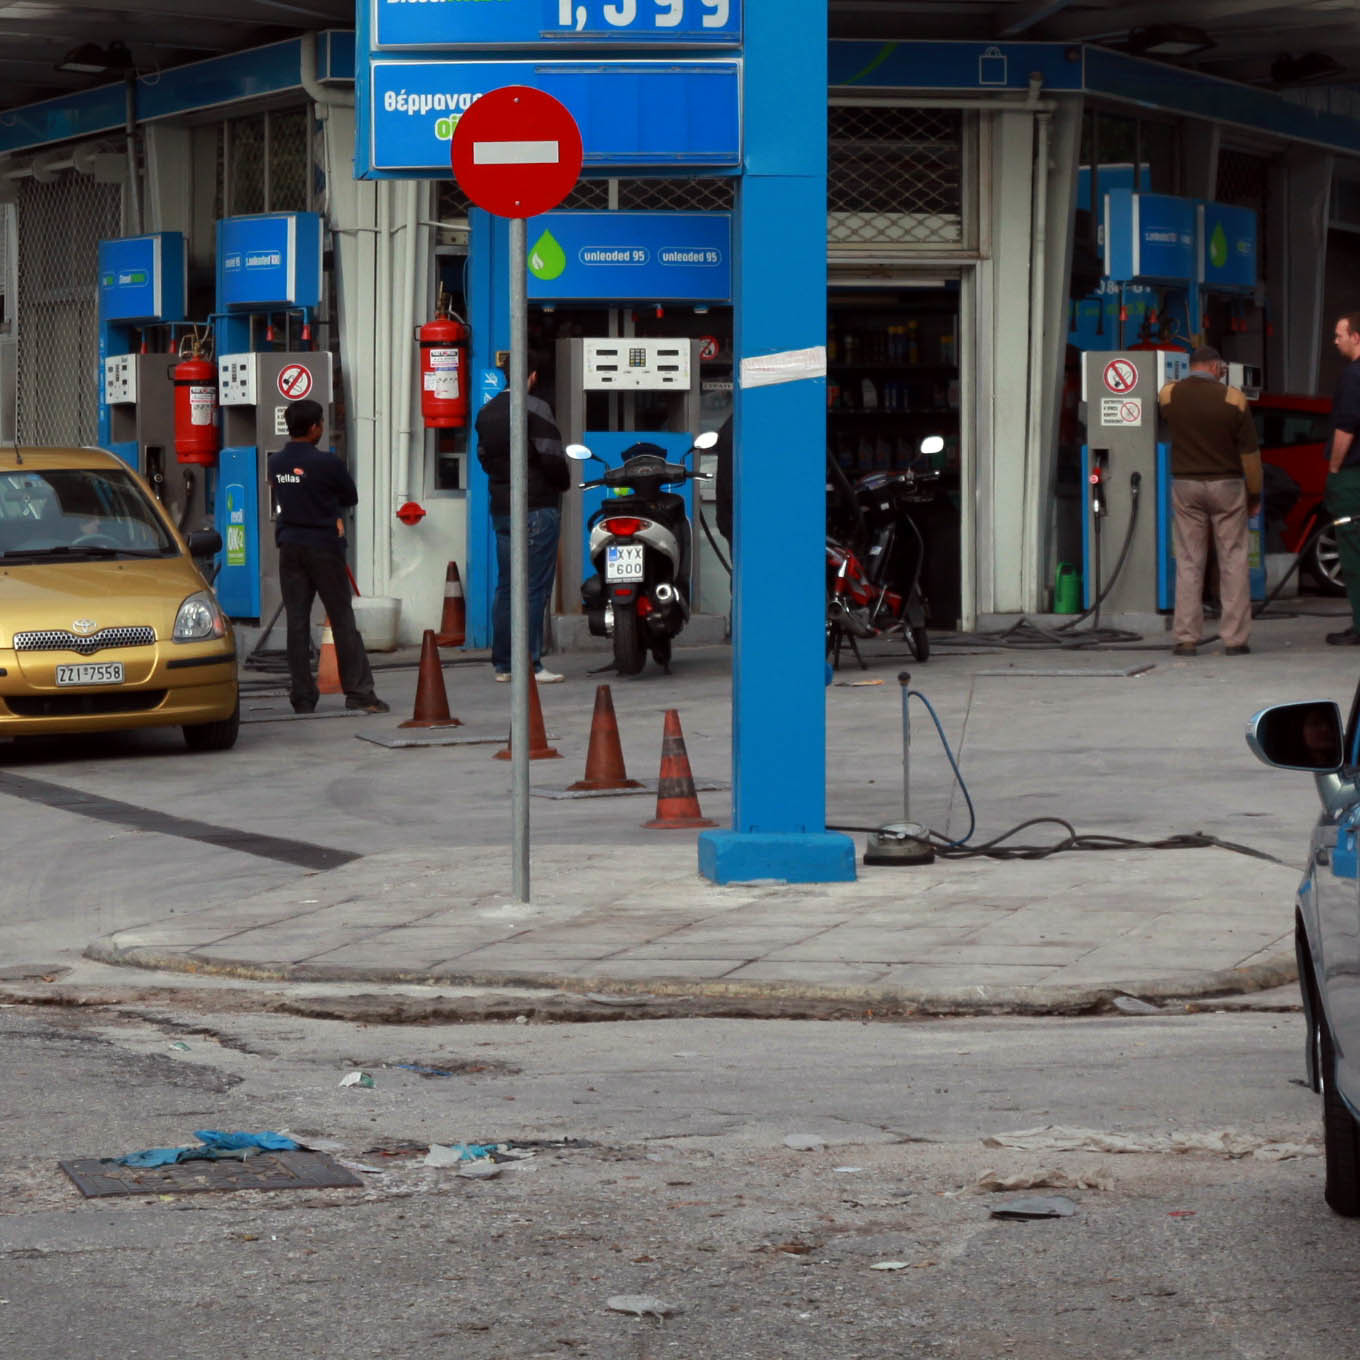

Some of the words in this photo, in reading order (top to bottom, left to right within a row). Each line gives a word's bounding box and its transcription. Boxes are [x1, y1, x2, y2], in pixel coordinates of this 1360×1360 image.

[584, 250, 630, 262] unleaded
[632, 250, 645, 262] 95
[663, 251, 703, 263] unleaded
[706, 251, 717, 263] 95
[276, 474, 300, 484] Tellas
[617, 564, 641, 575] 600
